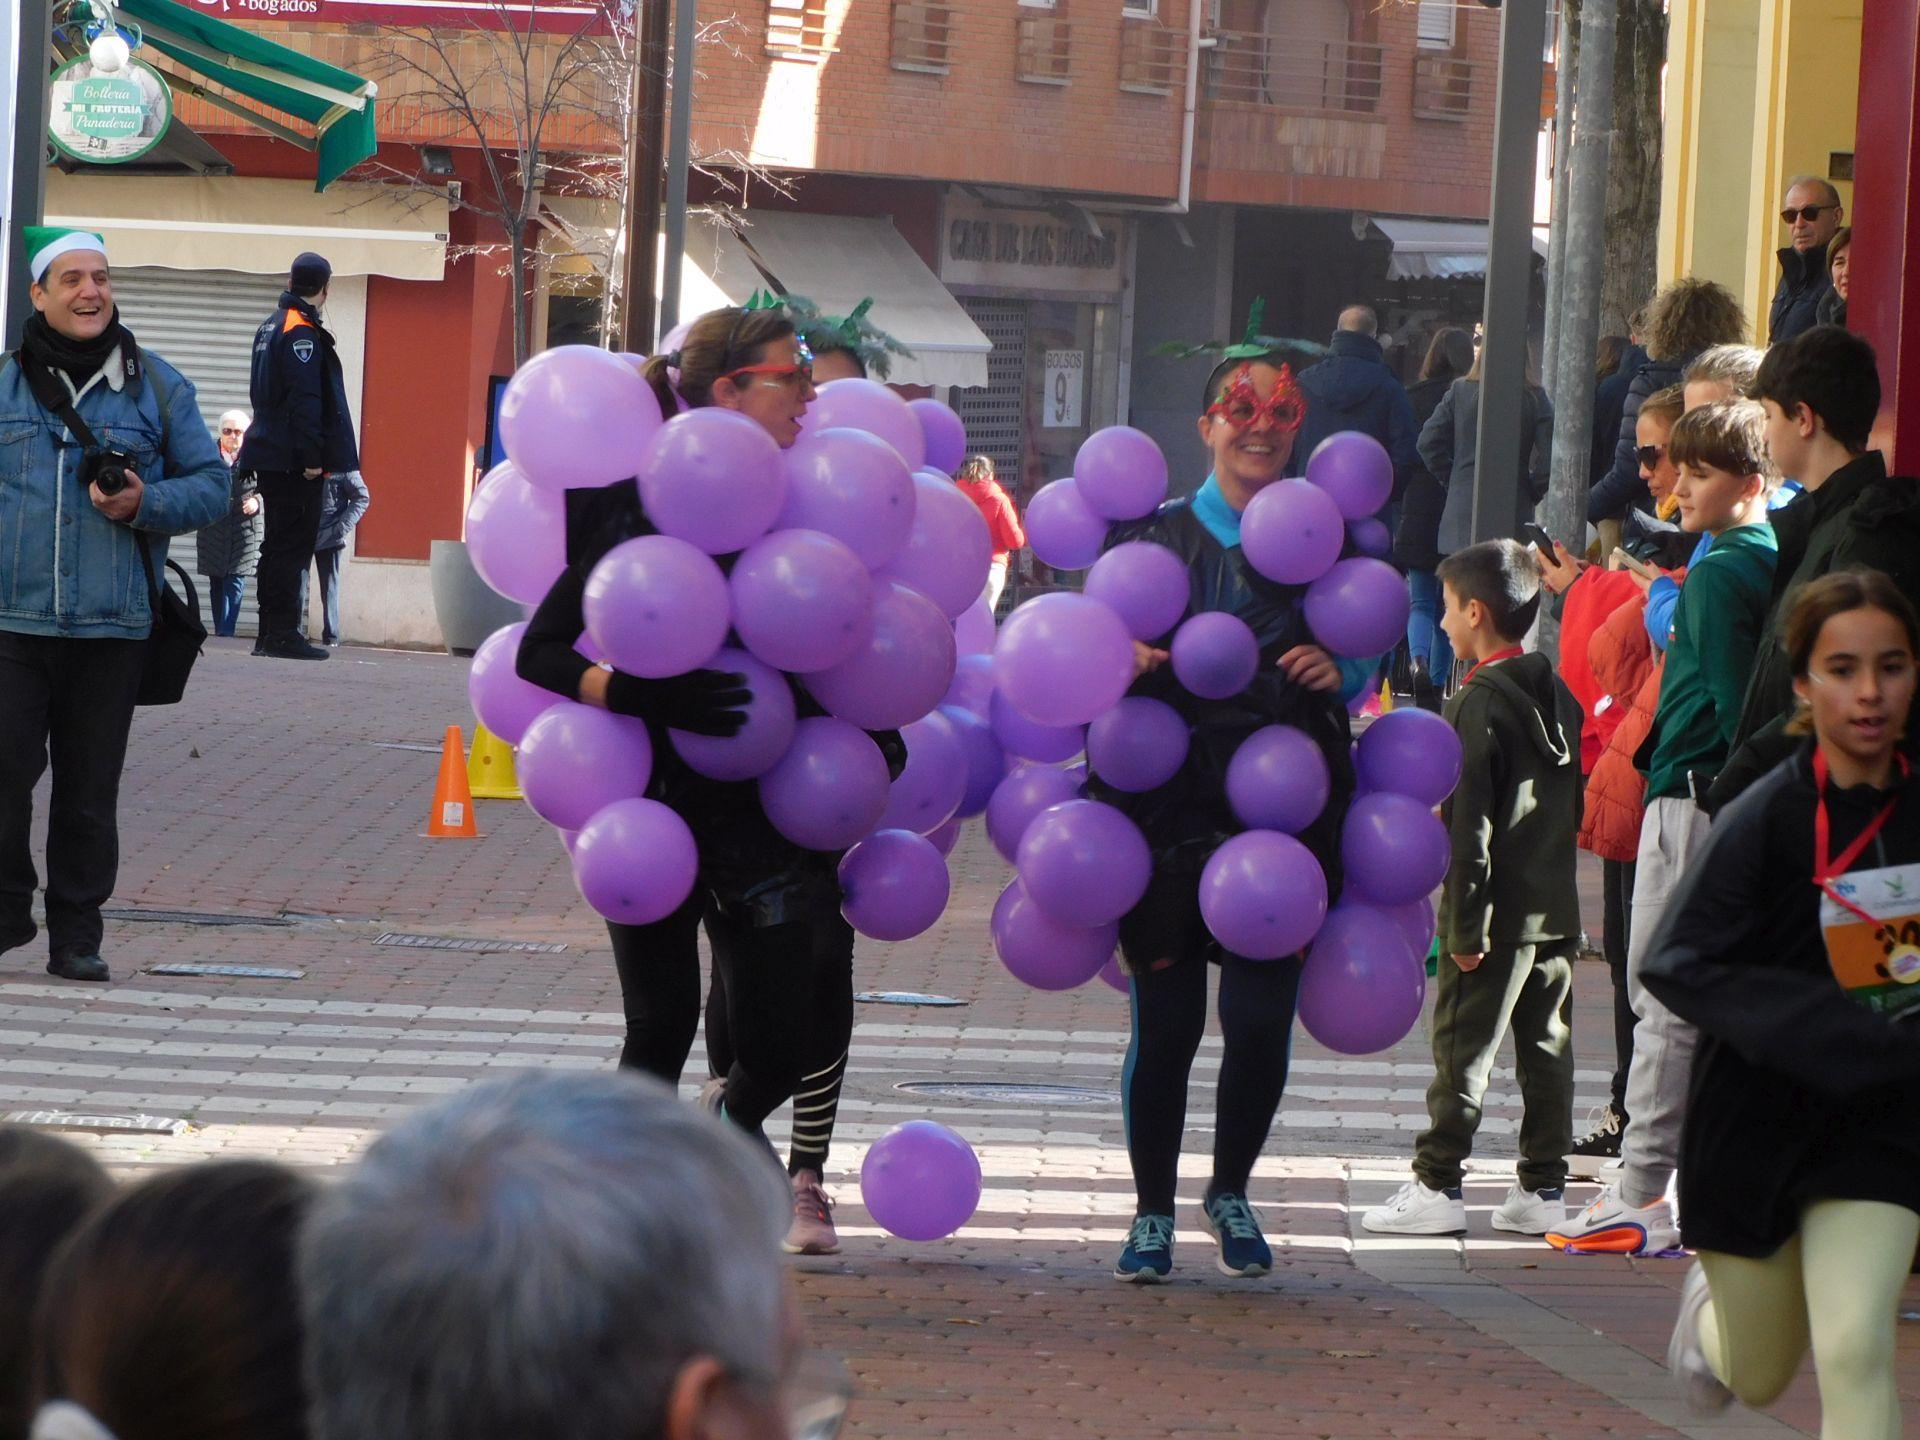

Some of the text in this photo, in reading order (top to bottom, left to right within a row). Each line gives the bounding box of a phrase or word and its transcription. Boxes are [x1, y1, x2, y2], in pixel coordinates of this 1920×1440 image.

[71, 103, 86, 113] MI
[126, 358, 135, 376] EOS
[1046, 352, 1082, 368] BOLSOS
